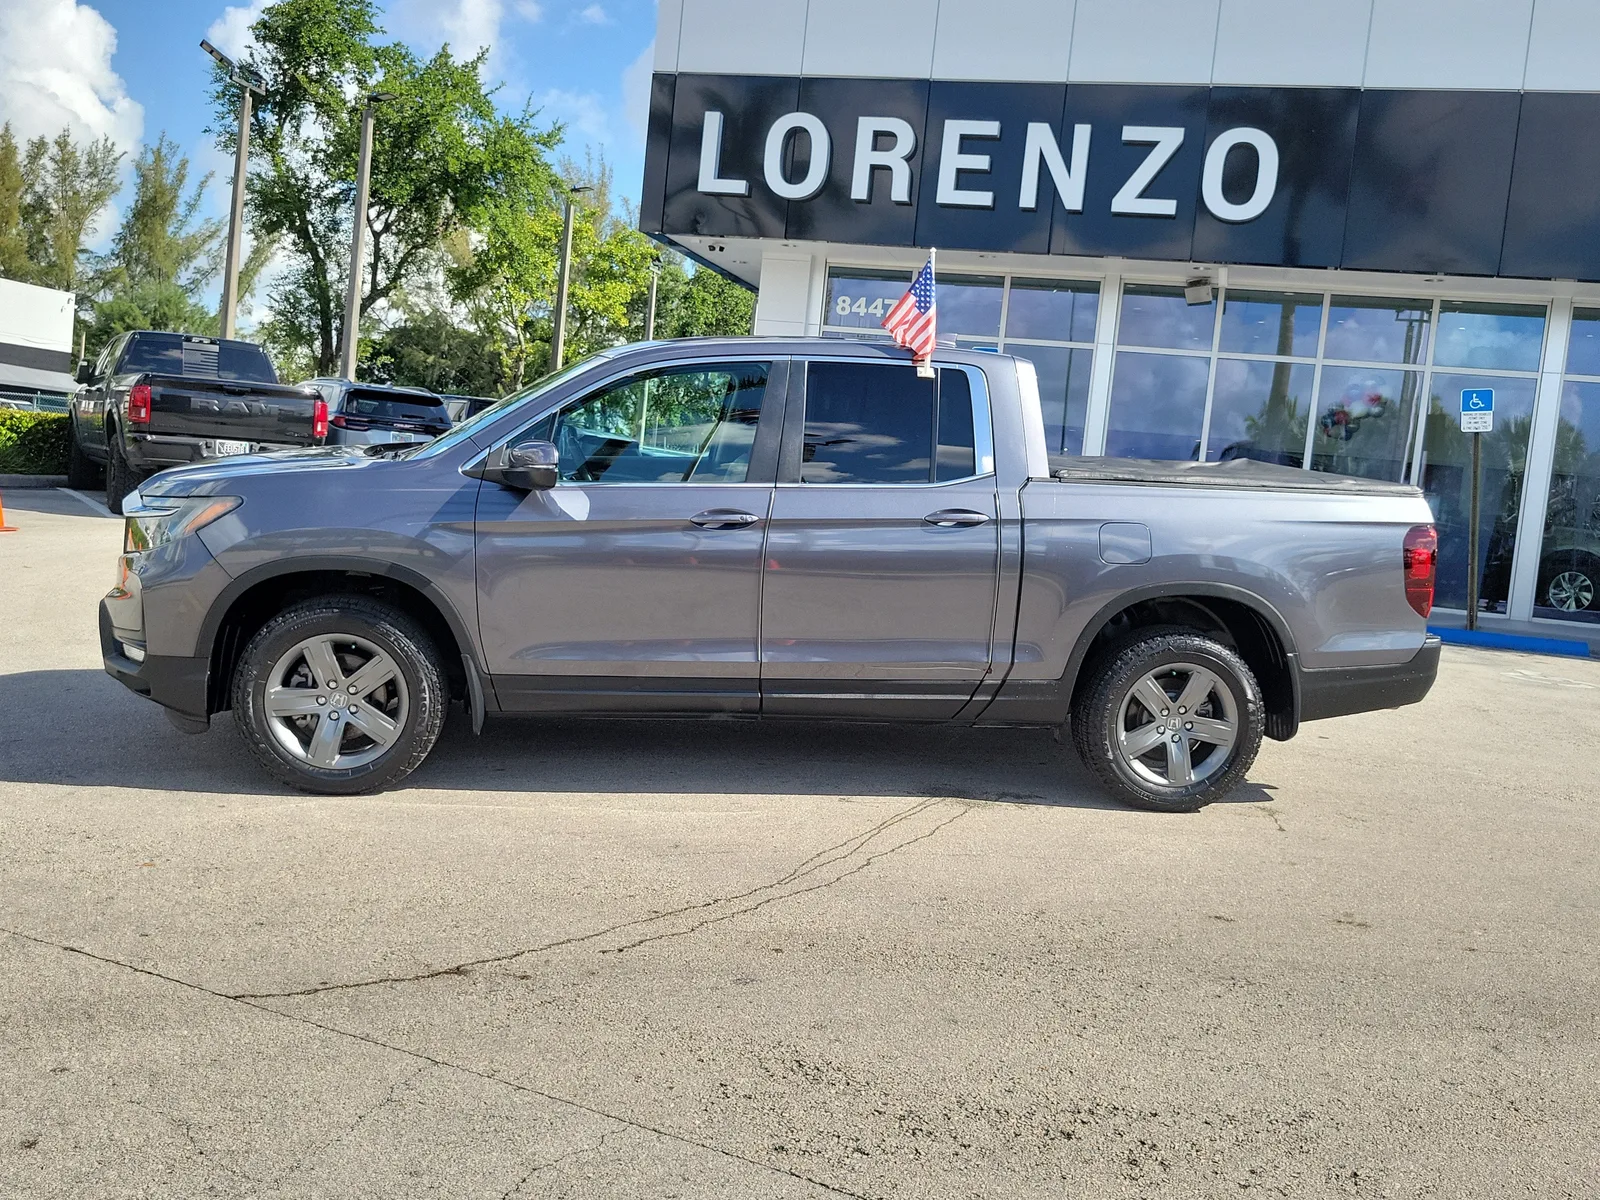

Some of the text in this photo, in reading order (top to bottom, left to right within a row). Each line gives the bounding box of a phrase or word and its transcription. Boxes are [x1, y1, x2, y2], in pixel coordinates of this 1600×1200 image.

[697, 109, 1280, 223] LORENZO
[836, 295, 900, 318] 8447
[190, 399, 279, 416] RAM
